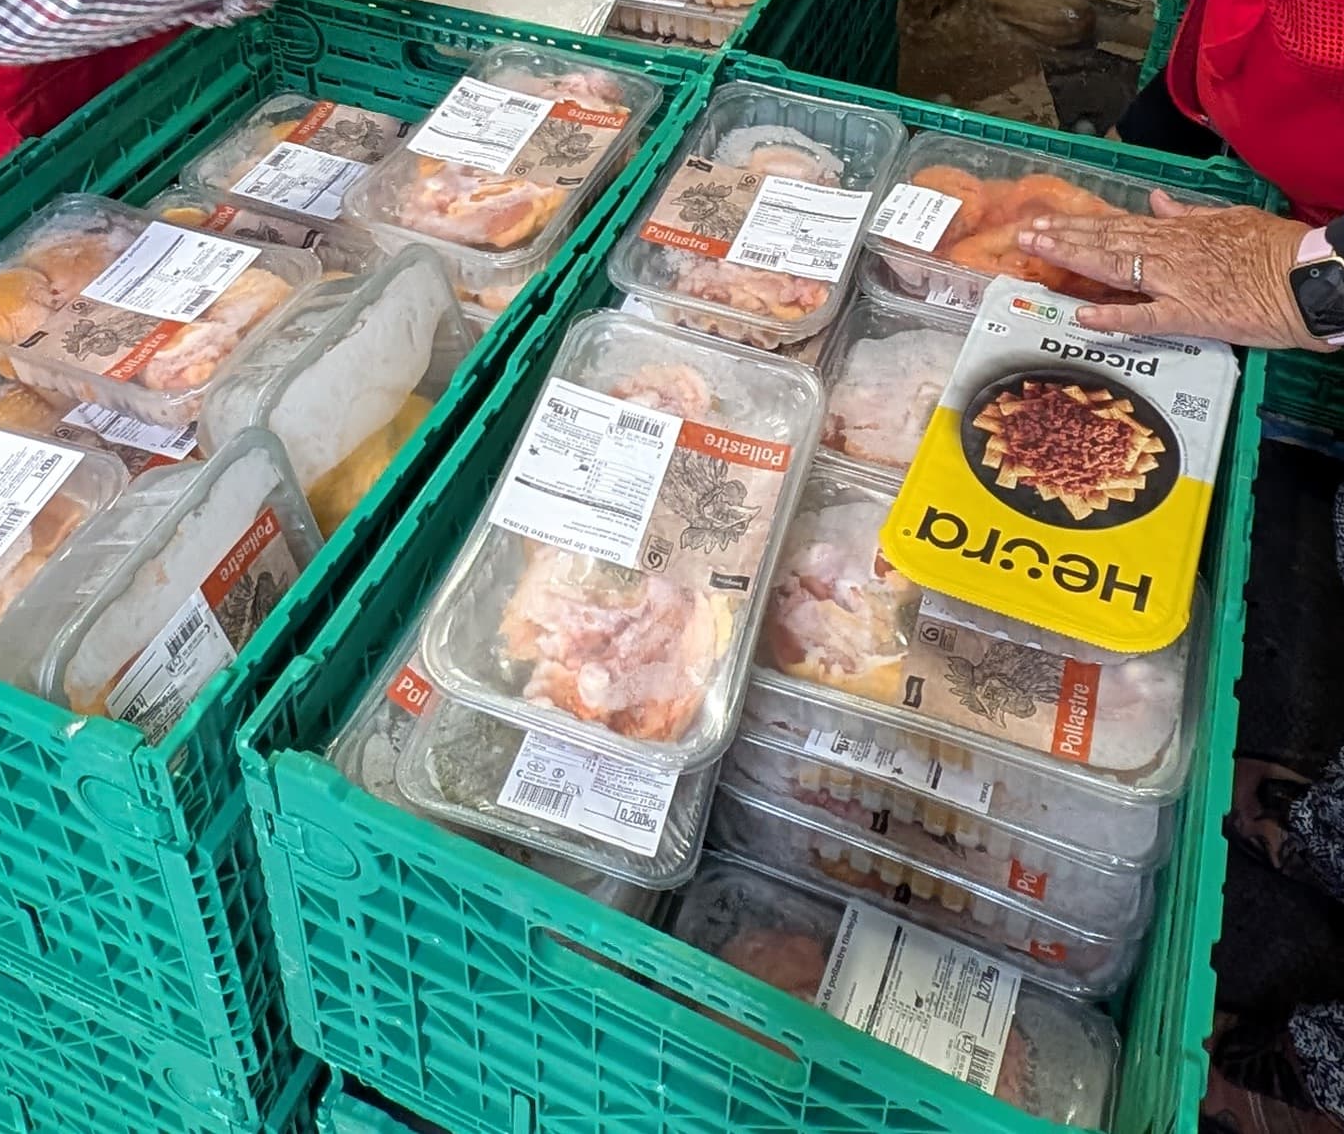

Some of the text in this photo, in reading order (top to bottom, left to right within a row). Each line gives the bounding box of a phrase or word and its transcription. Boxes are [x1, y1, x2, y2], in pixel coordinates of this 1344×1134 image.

[568, 106, 624, 128] Pollastre
[645, 225, 710, 252] Pollastre
[111, 331, 168, 382] Pollastre
[1039, 337, 1160, 377] picada
[1183, 343, 1202, 356] 49
[703, 433, 785, 467] Pollastre
[218, 520, 276, 582] Pollastre
[501, 516, 621, 561] Cuixes de pollastre brasa
[916, 505, 1152, 613] Heüra
[1060, 682, 1091, 756] Pollastre
